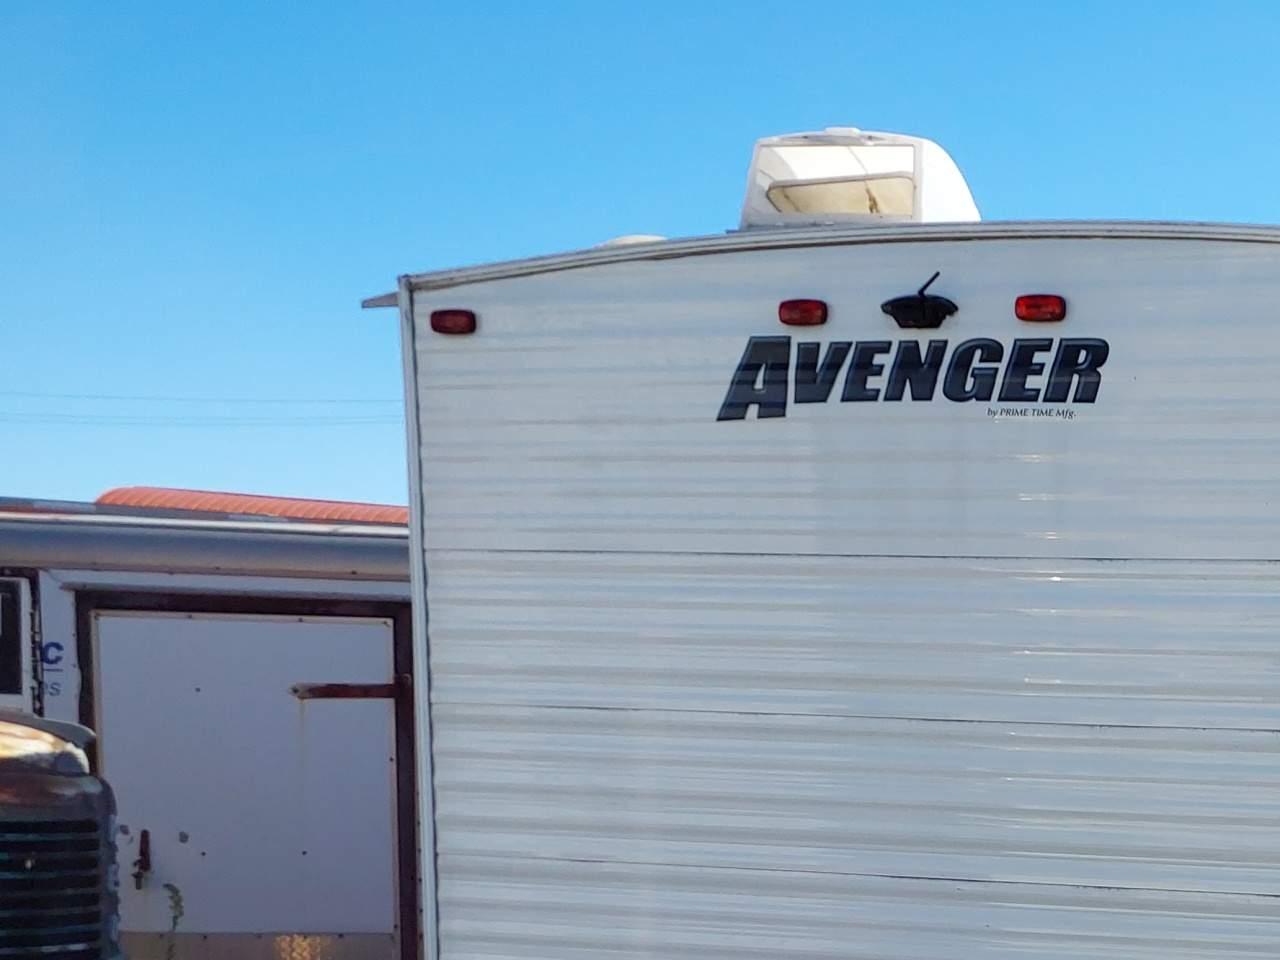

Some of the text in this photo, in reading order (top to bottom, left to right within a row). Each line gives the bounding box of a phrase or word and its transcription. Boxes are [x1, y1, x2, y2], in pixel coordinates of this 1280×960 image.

[715, 336, 1110, 422] AVENGER
[986, 407, 999, 418] by
[1000, 408, 1029, 417] PRIME
[1031, 408, 1054, 417] TIME
